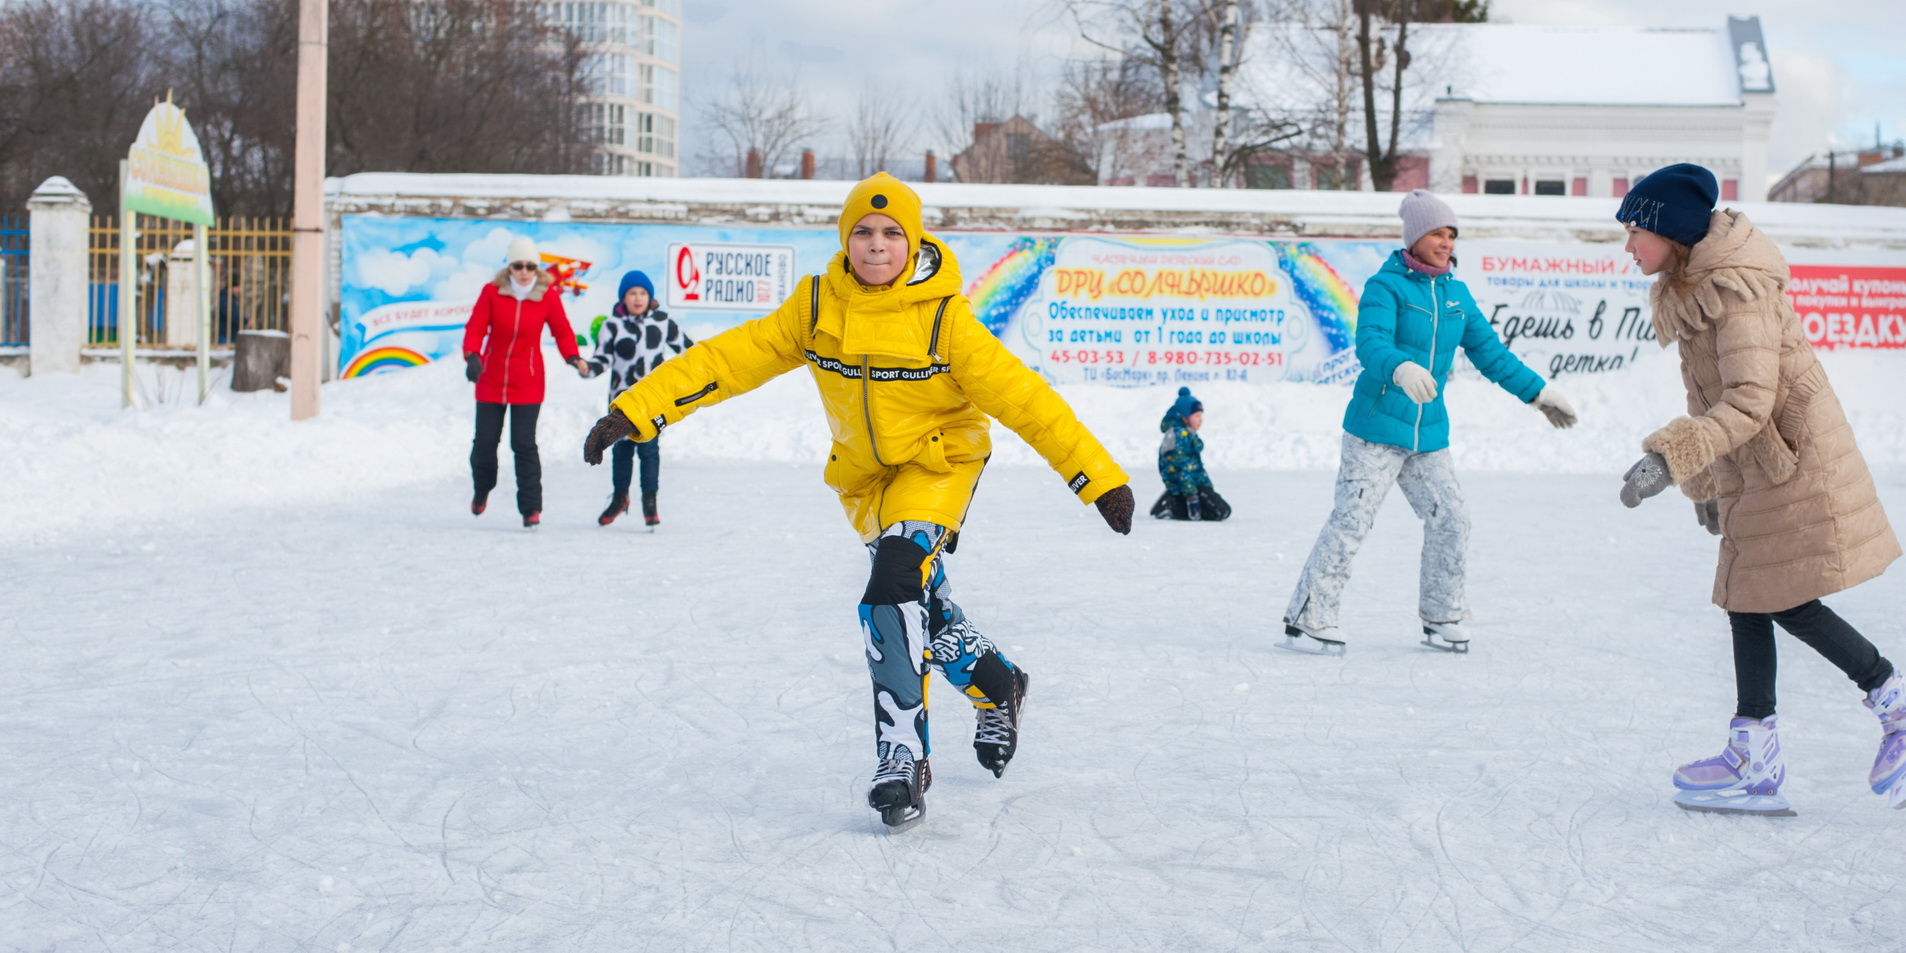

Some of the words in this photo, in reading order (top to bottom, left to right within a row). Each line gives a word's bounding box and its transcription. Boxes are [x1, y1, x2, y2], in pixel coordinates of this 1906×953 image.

[706, 252, 772, 276] РУССКОЕ
[1482, 254, 1615, 274] БУМАЖНЫЙ
[705, 279, 754, 302] РАДИО
[1109, 269, 1277, 299] «СОЛНЫШКО»
[1539, 278, 1561, 288] для
[1564, 278, 1606, 288] школы
[1622, 279, 1650, 291] твор
[1048, 302, 1154, 321] Обеспечиваем
[1161, 307, 1195, 325] уход
[1201, 309, 1209, 322] и
[1215, 308, 1285, 326] присмотр
[1491, 303, 1575, 350] Едешь
[1588, 299, 1607, 341] в
[1616, 307, 1657, 342] Пи
[1048, 329, 1064, 343] за
[1070, 329, 1122, 344] детьми
[1134, 329, 1150, 344] от
[1157, 327, 1163, 344] 1
[1169, 330, 1202, 345] года
[1209, 331, 1226, 345] до
[1233, 331, 1282, 345] школы
[1796, 312, 1906, 346] ОЕЗДКУ
[1051, 350, 1125, 364] 45-03-53
[1147, 351, 1283, 366] 8-980-735-02-51
[872, 369, 900, 380] SPORT
[941, 364, 950, 374] SP
